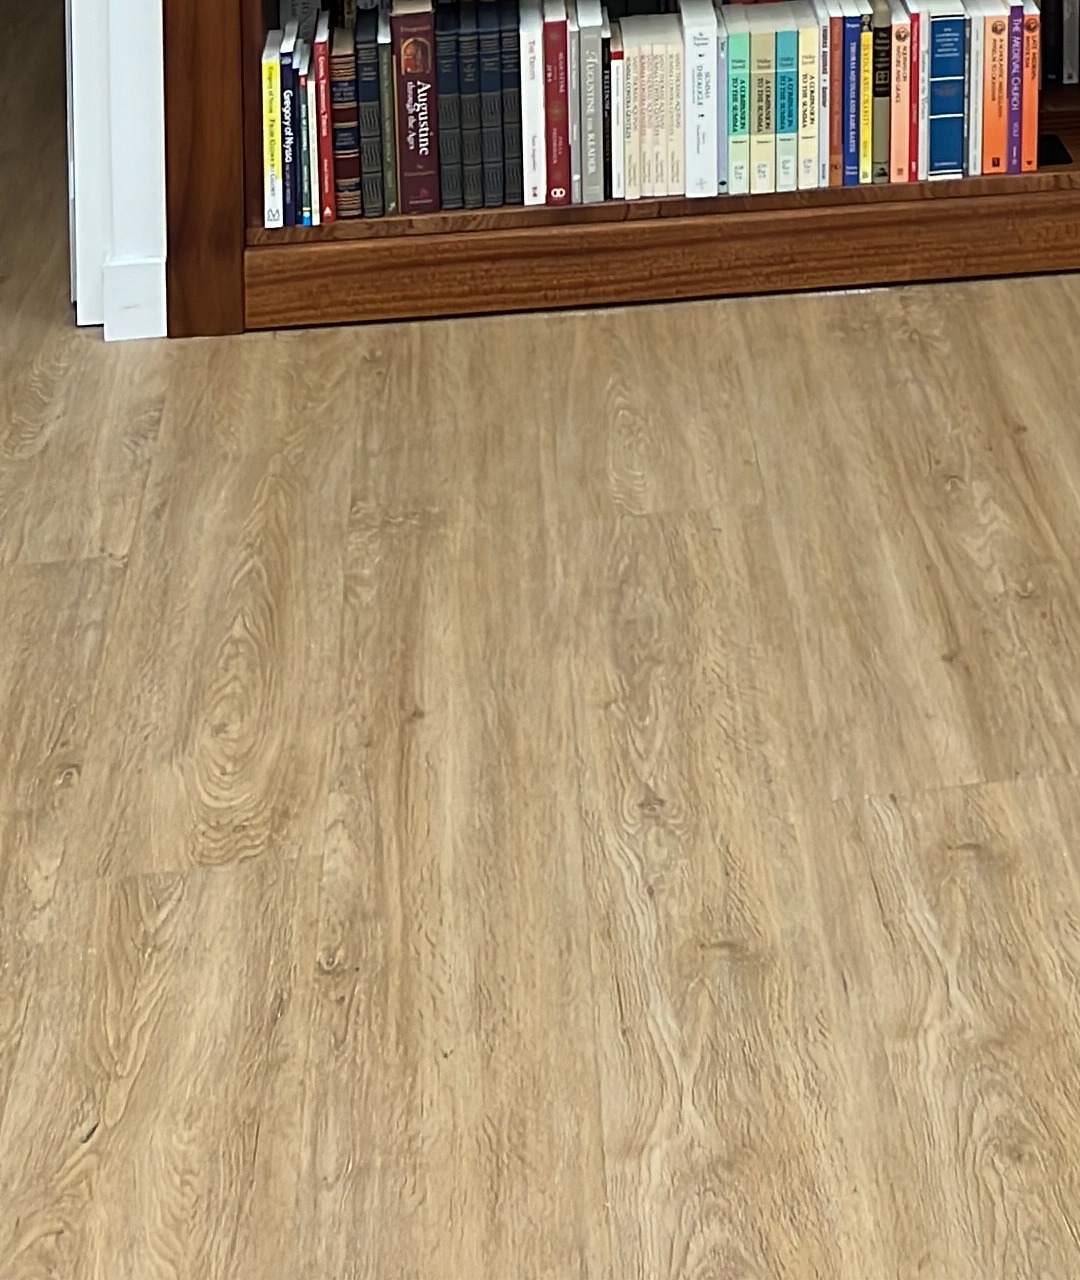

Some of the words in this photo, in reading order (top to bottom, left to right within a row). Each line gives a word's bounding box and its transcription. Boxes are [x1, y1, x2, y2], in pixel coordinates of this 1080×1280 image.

[1012, 18, 1021, 32] THE
[1012, 36, 1021, 74] MEDIEVAL
[406, 82, 416, 114] through
[1011, 77, 1021, 110] CHURCH
[282, 90, 293, 126] Gregory
[415, 81, 433, 155] Augustine
[284, 127, 293, 136] of
[408, 116, 416, 129] the
[284, 137, 294, 162] Nyssa
[407, 131, 415, 150] Ages
